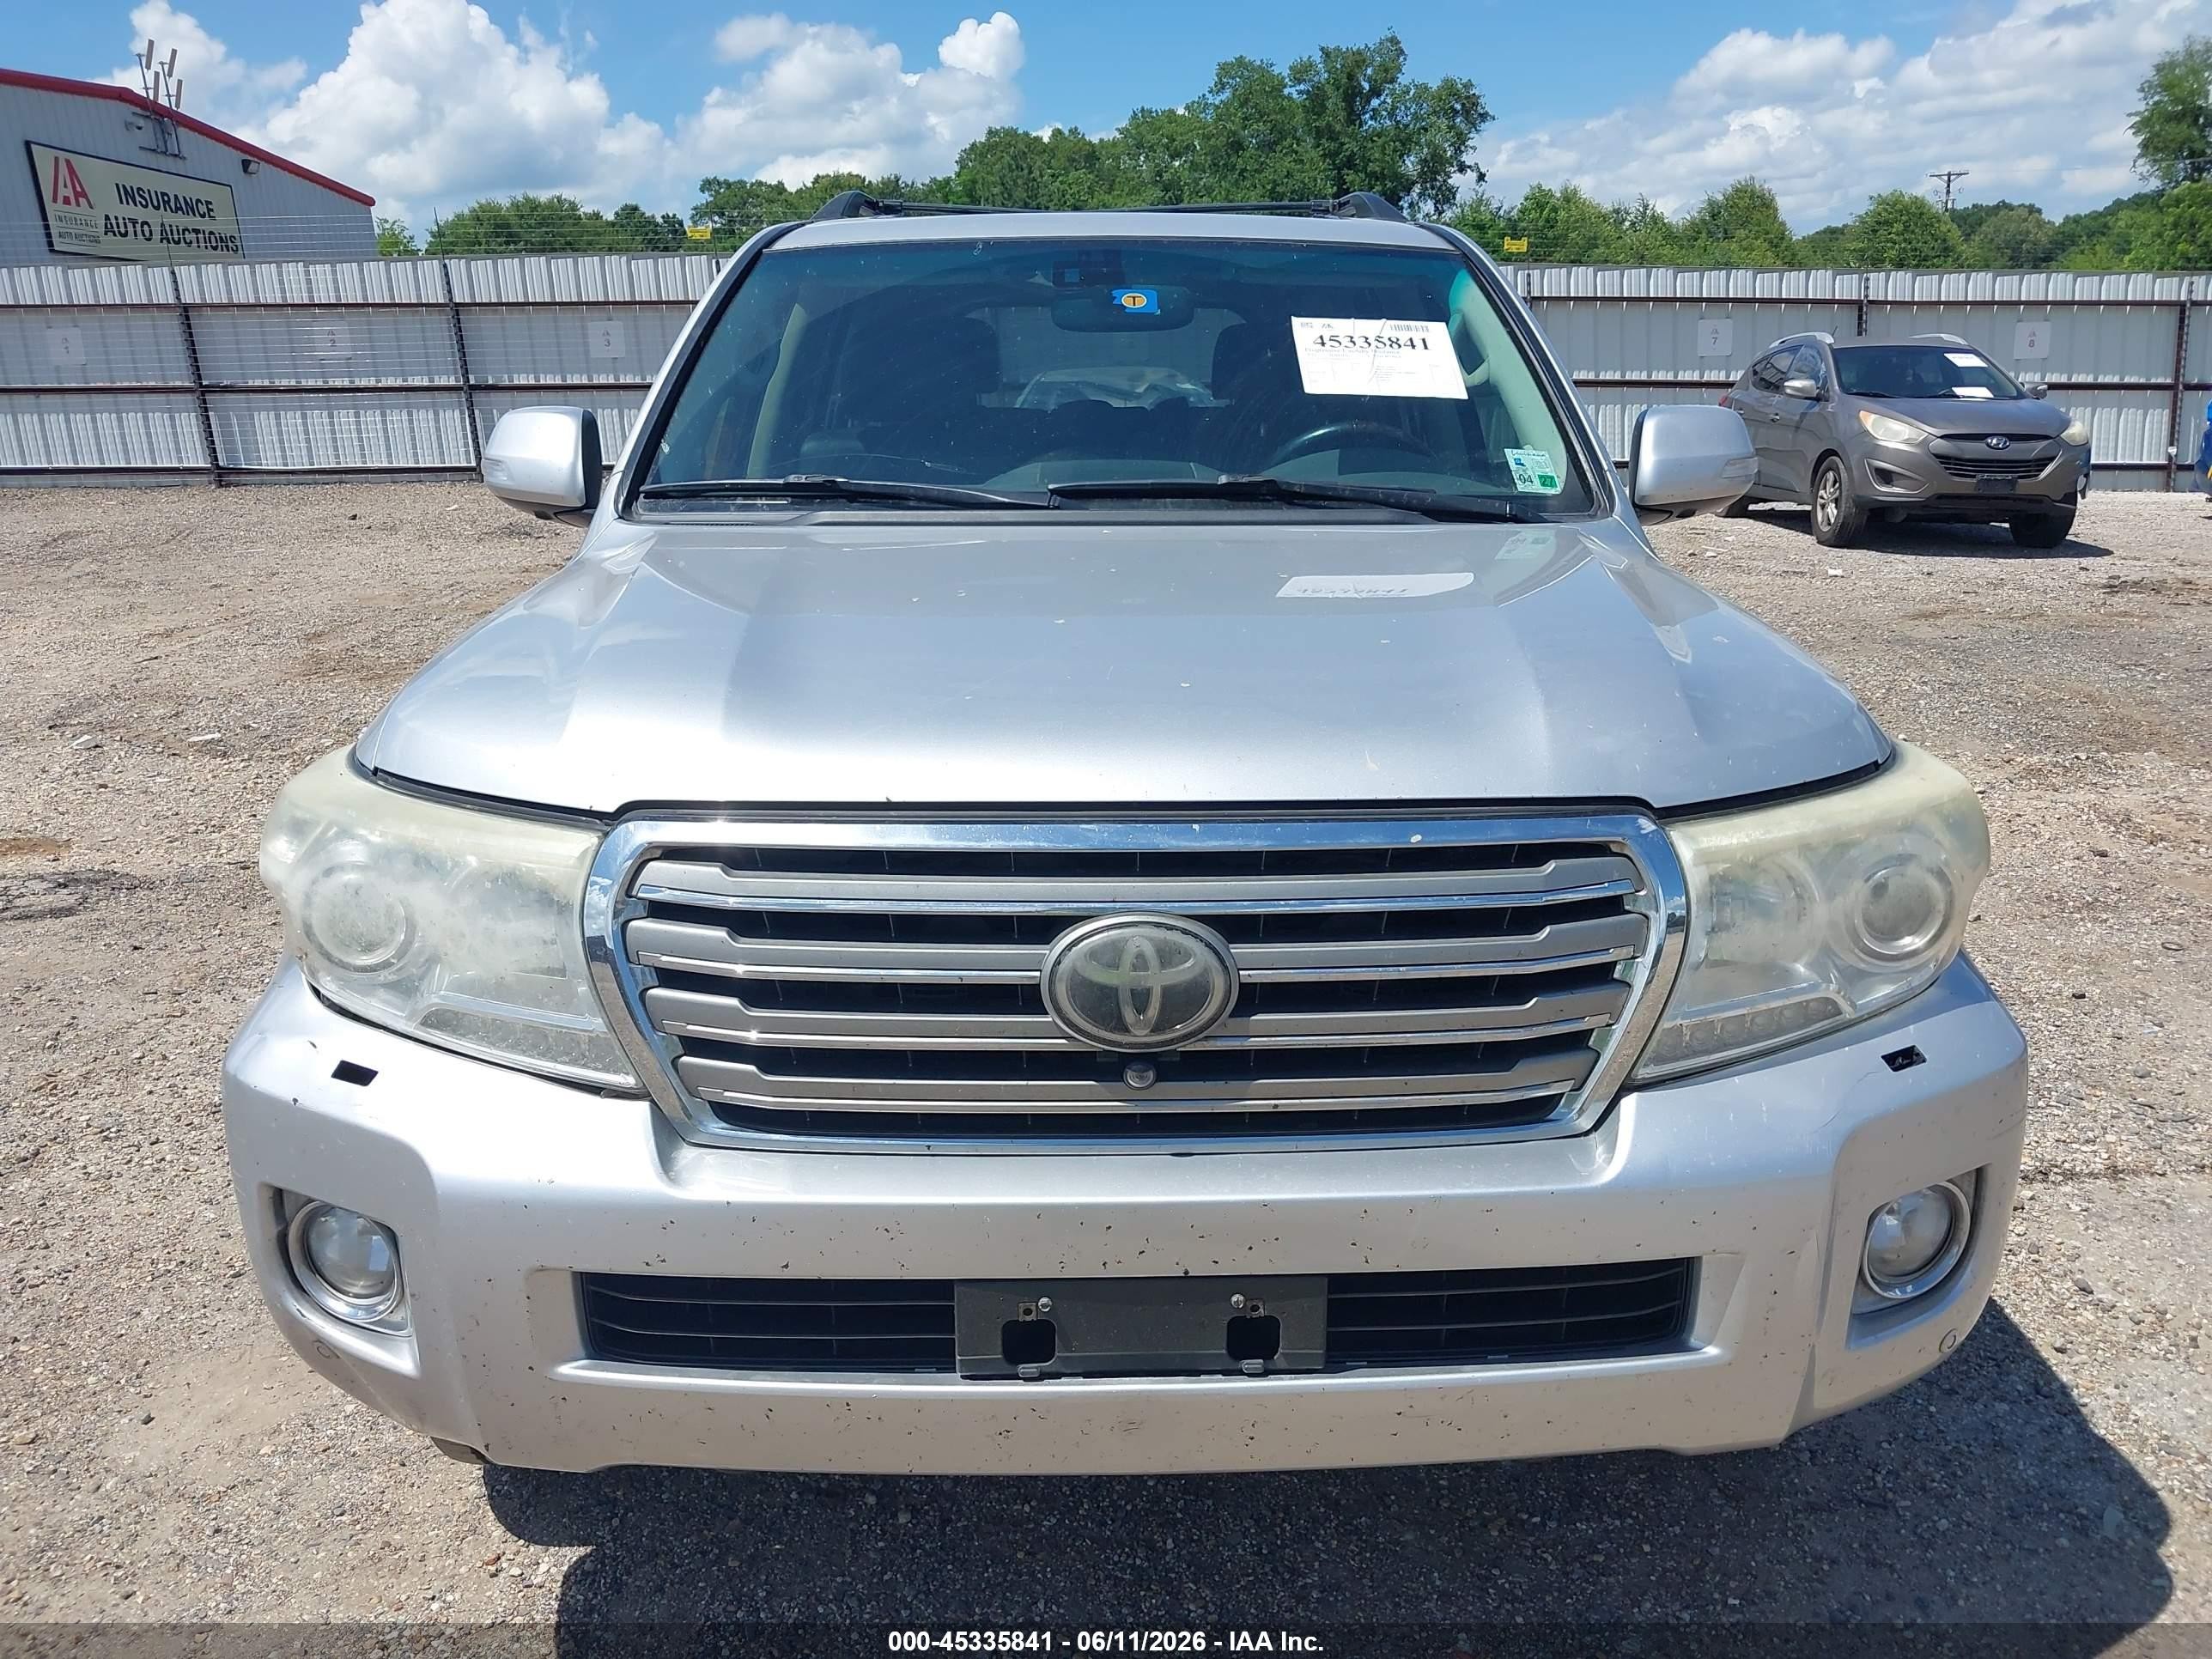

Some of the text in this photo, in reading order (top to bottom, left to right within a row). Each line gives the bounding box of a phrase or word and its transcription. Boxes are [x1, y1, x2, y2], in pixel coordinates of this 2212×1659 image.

[115, 183, 216, 221] INSURANCE
[104, 214, 239, 254] AUTO AUCTIONS
[604, 338, 611, 347] 3
[1312, 334, 1431, 350] 45335841
[2028, 339, 2035, 348] 8
[1519, 474, 1534, 485] 04
